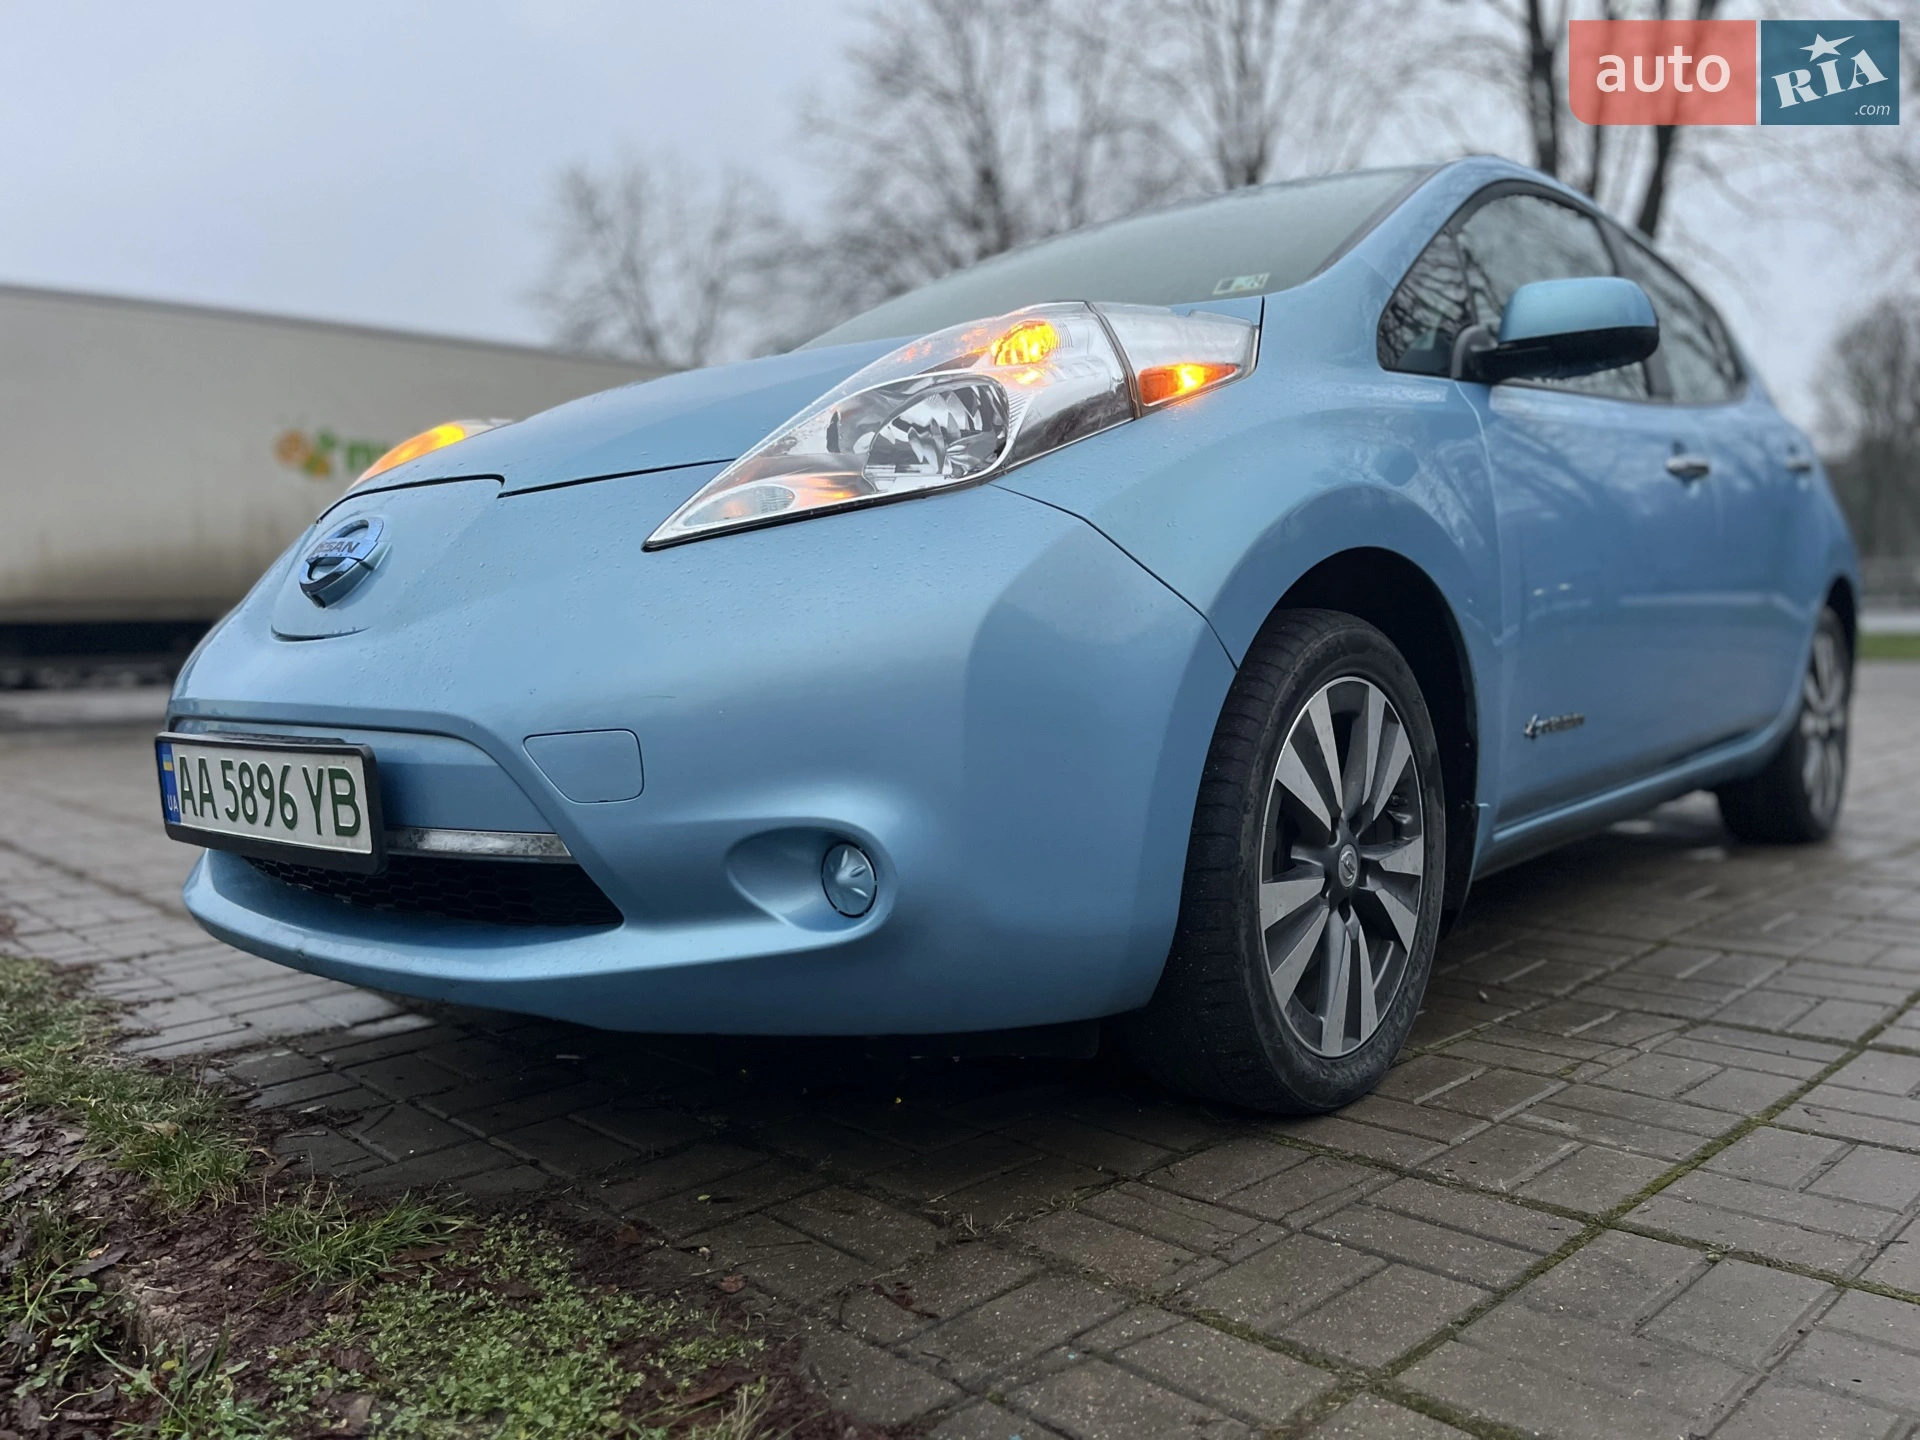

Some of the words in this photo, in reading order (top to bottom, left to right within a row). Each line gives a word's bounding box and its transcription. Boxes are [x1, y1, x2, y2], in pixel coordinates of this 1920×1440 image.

[167, 794, 179, 812] UA
[179, 755, 218, 819] AA
[220, 758, 298, 830] 5896
[302, 766, 361, 836] YB
